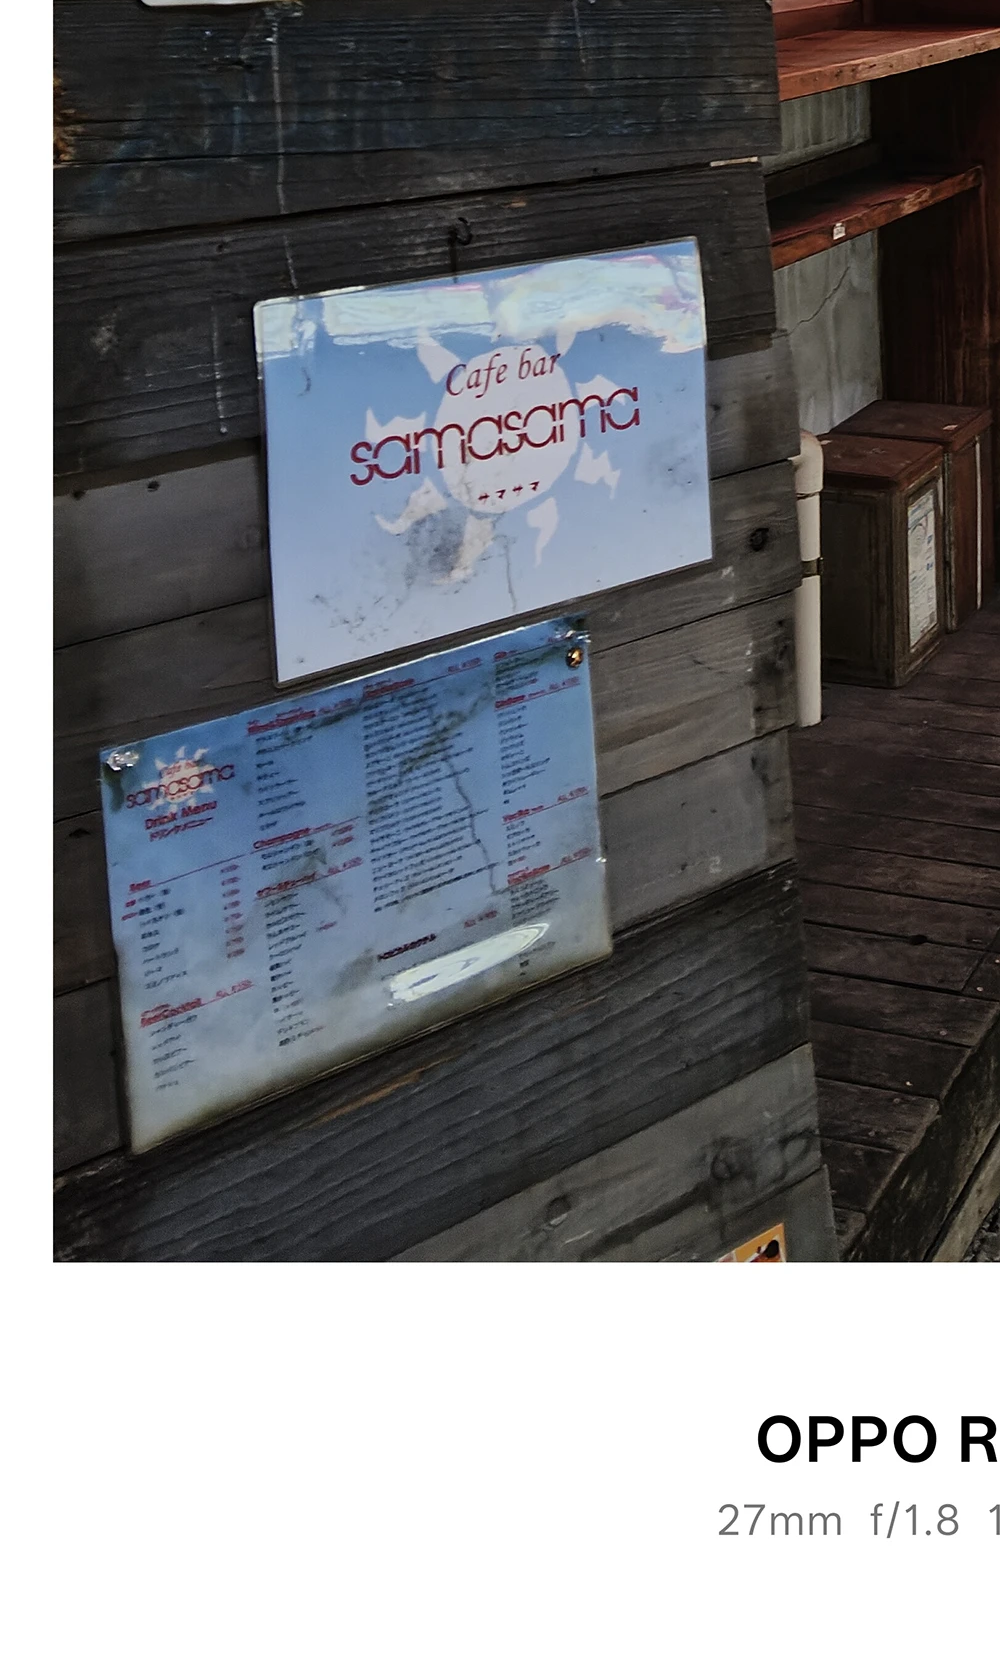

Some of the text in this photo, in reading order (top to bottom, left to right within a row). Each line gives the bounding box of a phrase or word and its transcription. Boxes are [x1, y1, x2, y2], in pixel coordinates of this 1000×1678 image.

[445, 348, 561, 398] Cafe bar
[350, 386, 640, 486] samasama
[477, 480, 541, 502] サマサマ
[126, 764, 236, 810] samasama
[144, 800, 218, 830] Drink Menu
